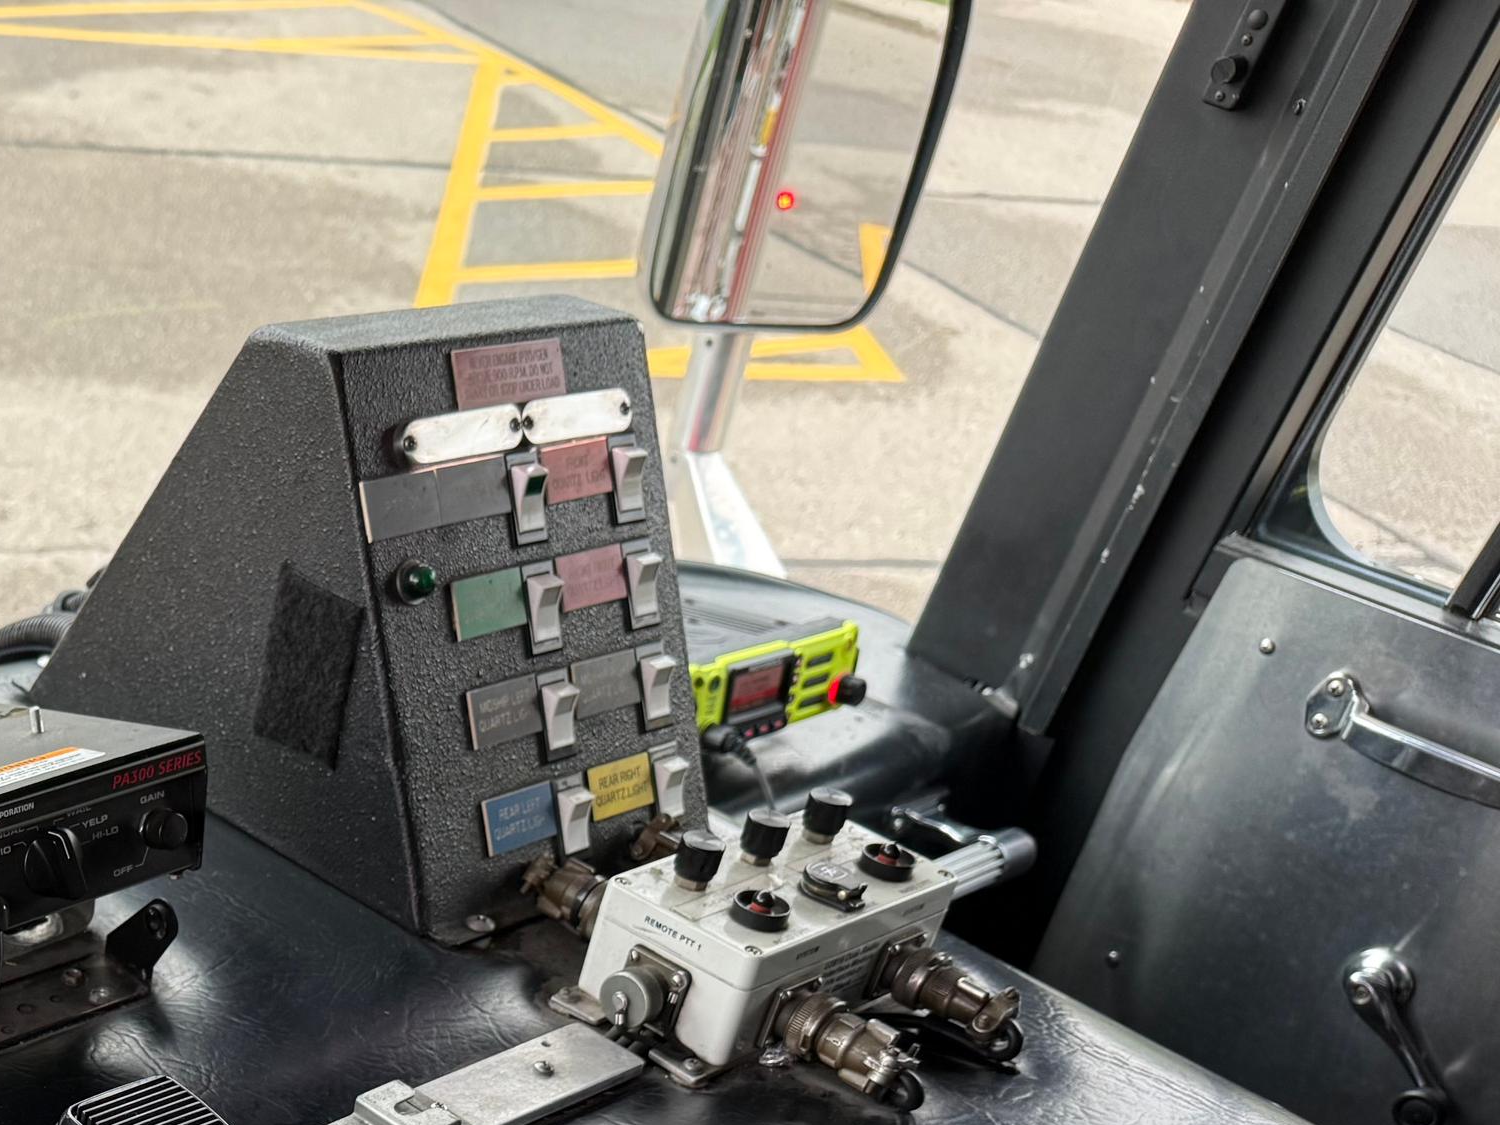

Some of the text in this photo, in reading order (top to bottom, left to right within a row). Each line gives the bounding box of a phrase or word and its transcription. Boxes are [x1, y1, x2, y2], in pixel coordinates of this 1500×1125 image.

[111, 766, 155, 790] PA300
[158, 750, 202, 776] SERIES
[598, 767, 641, 790] REAR RIGHT
[139, 790, 165, 805] GAIN
[595, 782, 649, 808] QUARTZ LIGHT
[82, 814, 109, 829] YELP
[92, 825, 119, 841] HI-LO
[113, 864, 134, 878] OFF
[644, 915, 678, 939] REMOTE
[680, 933, 696, 947] PTT
